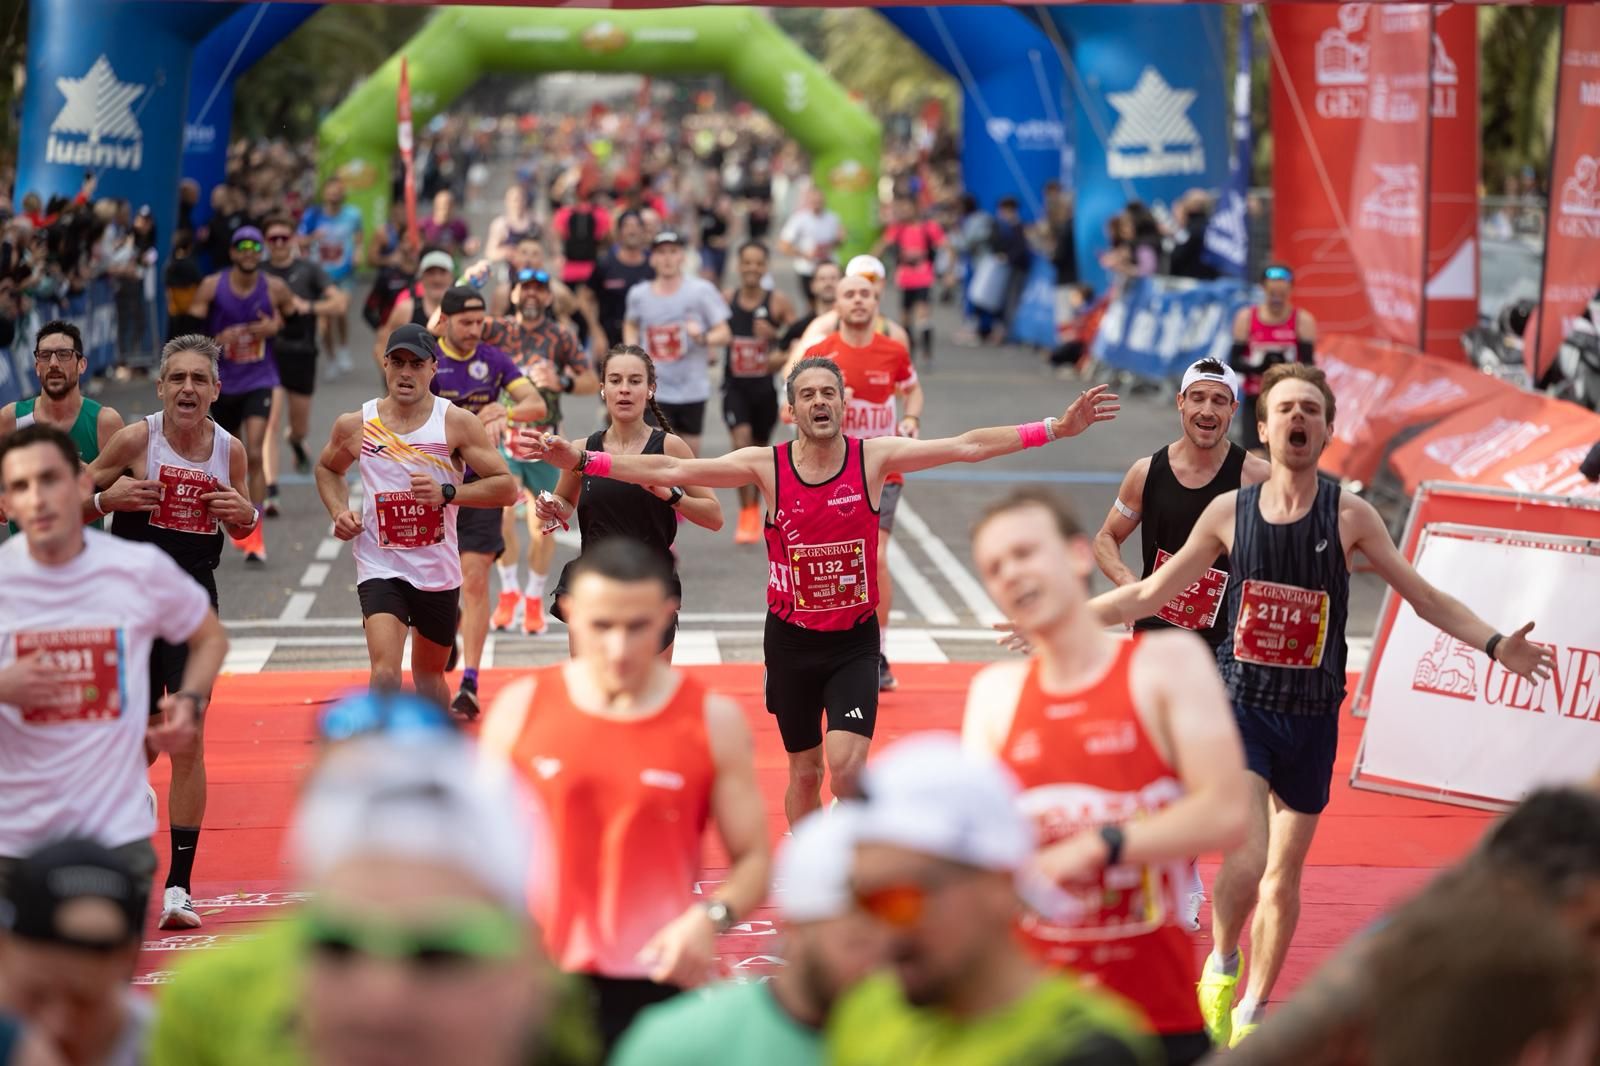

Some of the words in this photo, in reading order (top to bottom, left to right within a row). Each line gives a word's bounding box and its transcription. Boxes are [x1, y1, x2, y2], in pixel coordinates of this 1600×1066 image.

[45, 133, 143, 170] luanvi
[177, 468, 212, 483] GENER
[177, 483, 202, 497] 877
[827, 494, 862, 506] MANCHATHON
[392, 504, 425, 517] 1146
[807, 544, 854, 558] GENERALI
[808, 560, 844, 575] 1132
[1263, 586, 1318, 605] GENERALI
[1257, 602, 1301, 625] 2114
[1485, 638, 1600, 723] GENE
